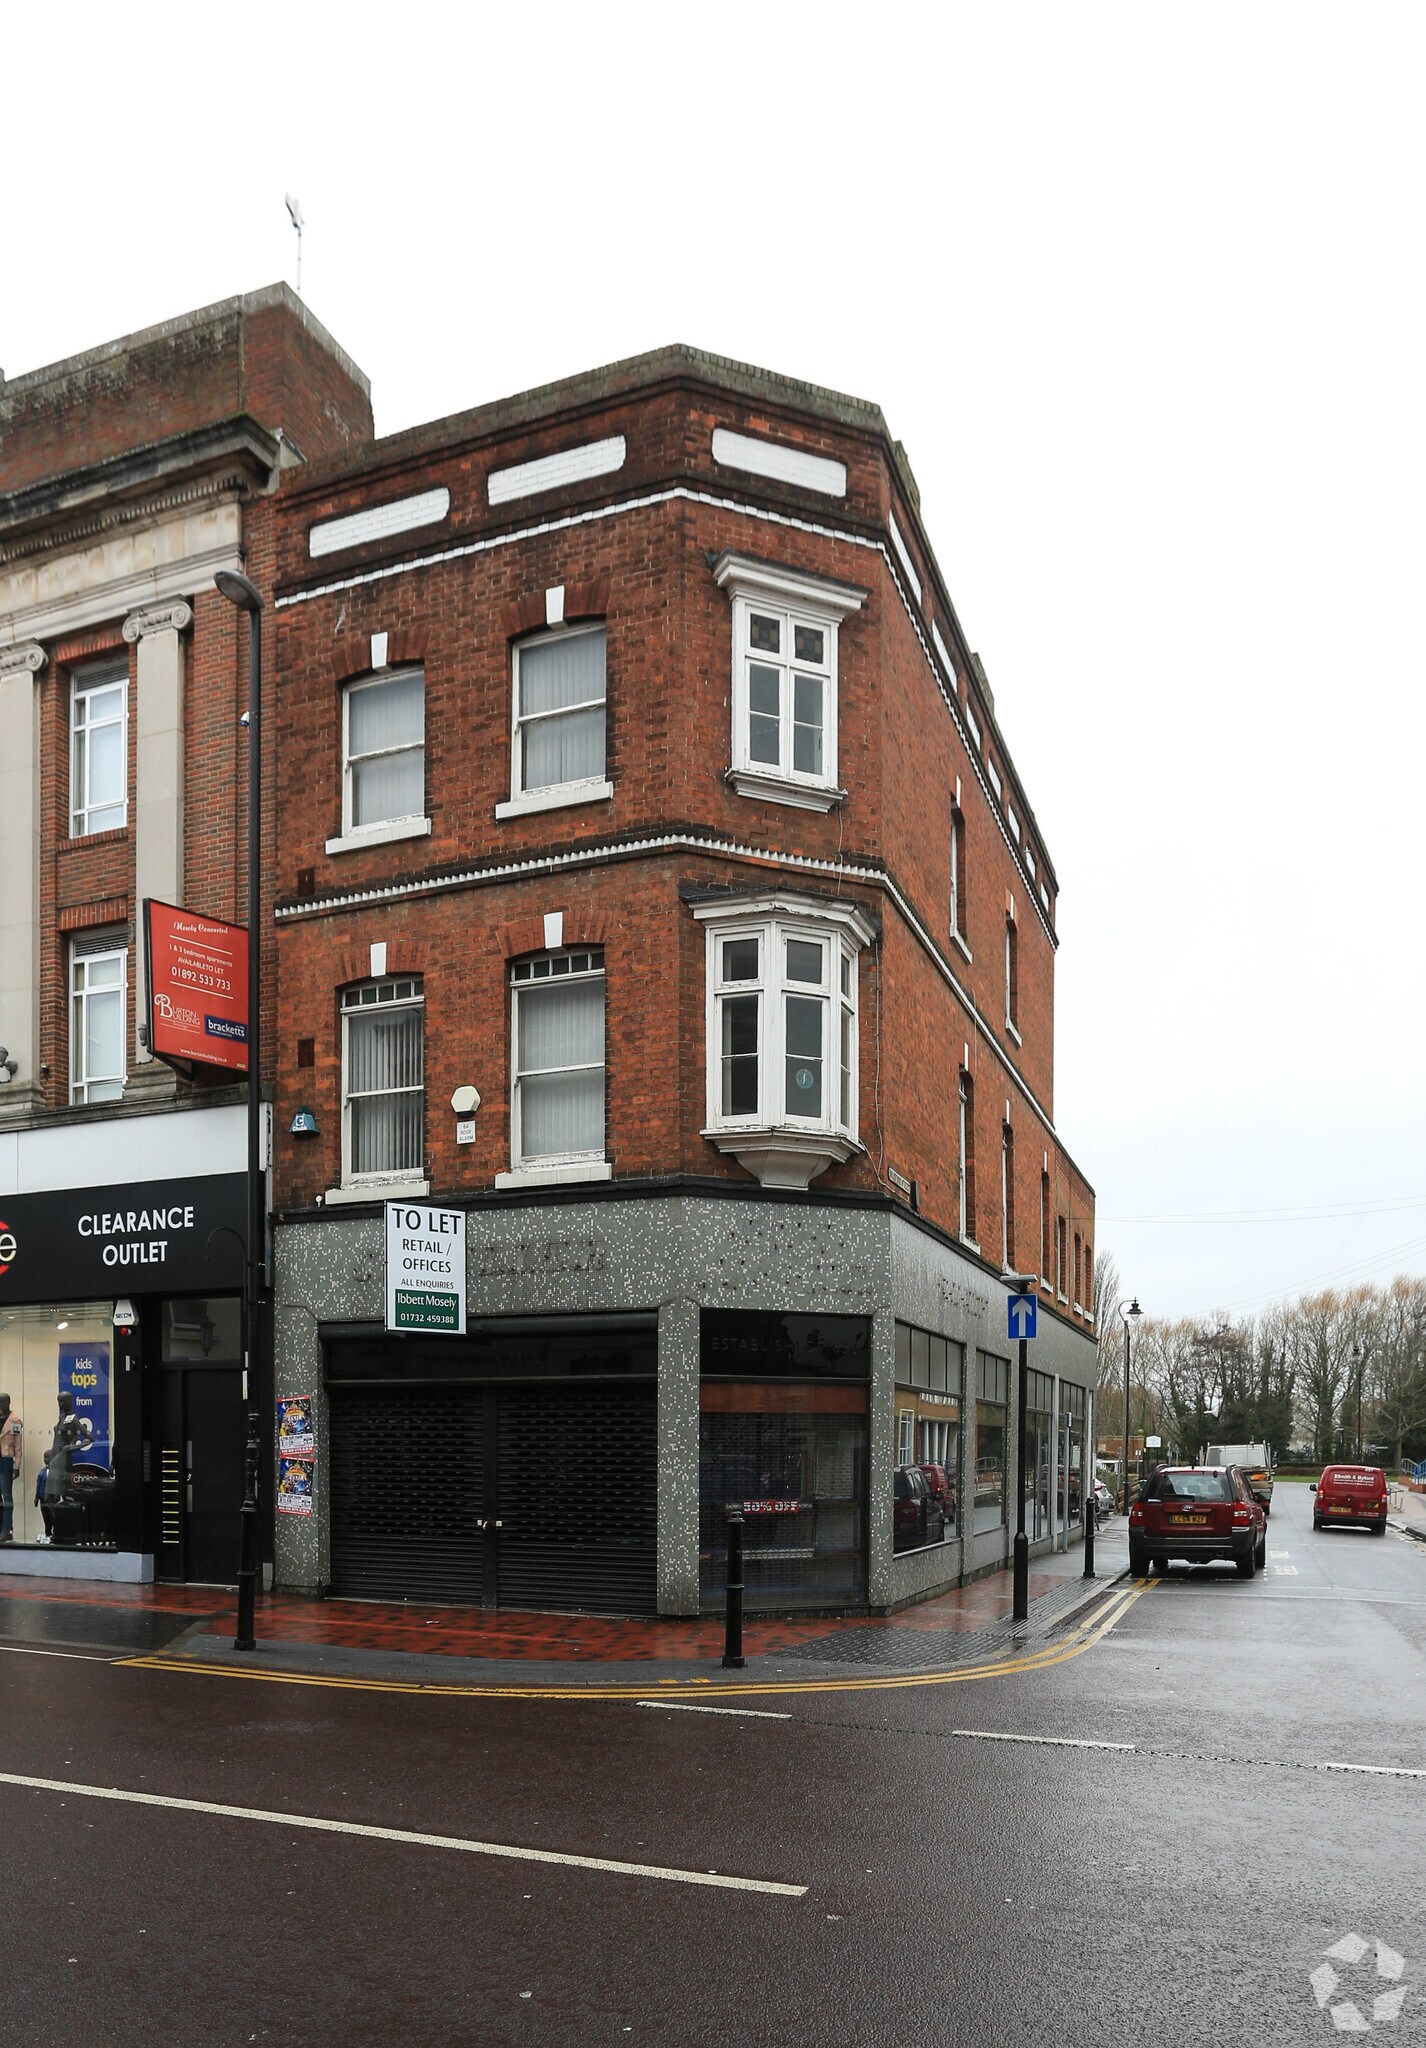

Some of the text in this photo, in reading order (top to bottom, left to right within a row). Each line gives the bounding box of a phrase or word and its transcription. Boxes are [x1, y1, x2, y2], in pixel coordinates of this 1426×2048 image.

[184, 948, 206, 959] bedroom
[171, 966, 231, 991] 01892 533 733
[214, 966, 224, 975] LET
[208, 1019, 245, 1037] bracketts
[78, 1206, 194, 1236] CLEARANCE
[392, 1208, 461, 1235] TO LET
[102, 1241, 168, 1266] OUTLET
[402, 1238, 452, 1256] RETAIL /
[402, 1257, 452, 1273] OFFICES
[401, 1278, 454, 1289] ALL ENQUIRIES
[397, 1293, 456, 1310] Ibbett Mosely
[400, 1313, 454, 1324] 01732 459388
[75, 1358, 92, 1370] kids
[71, 1371, 97, 1388] tops
[75, 1396, 93, 1406] from
[774, 1501, 798, 1511] OFF
